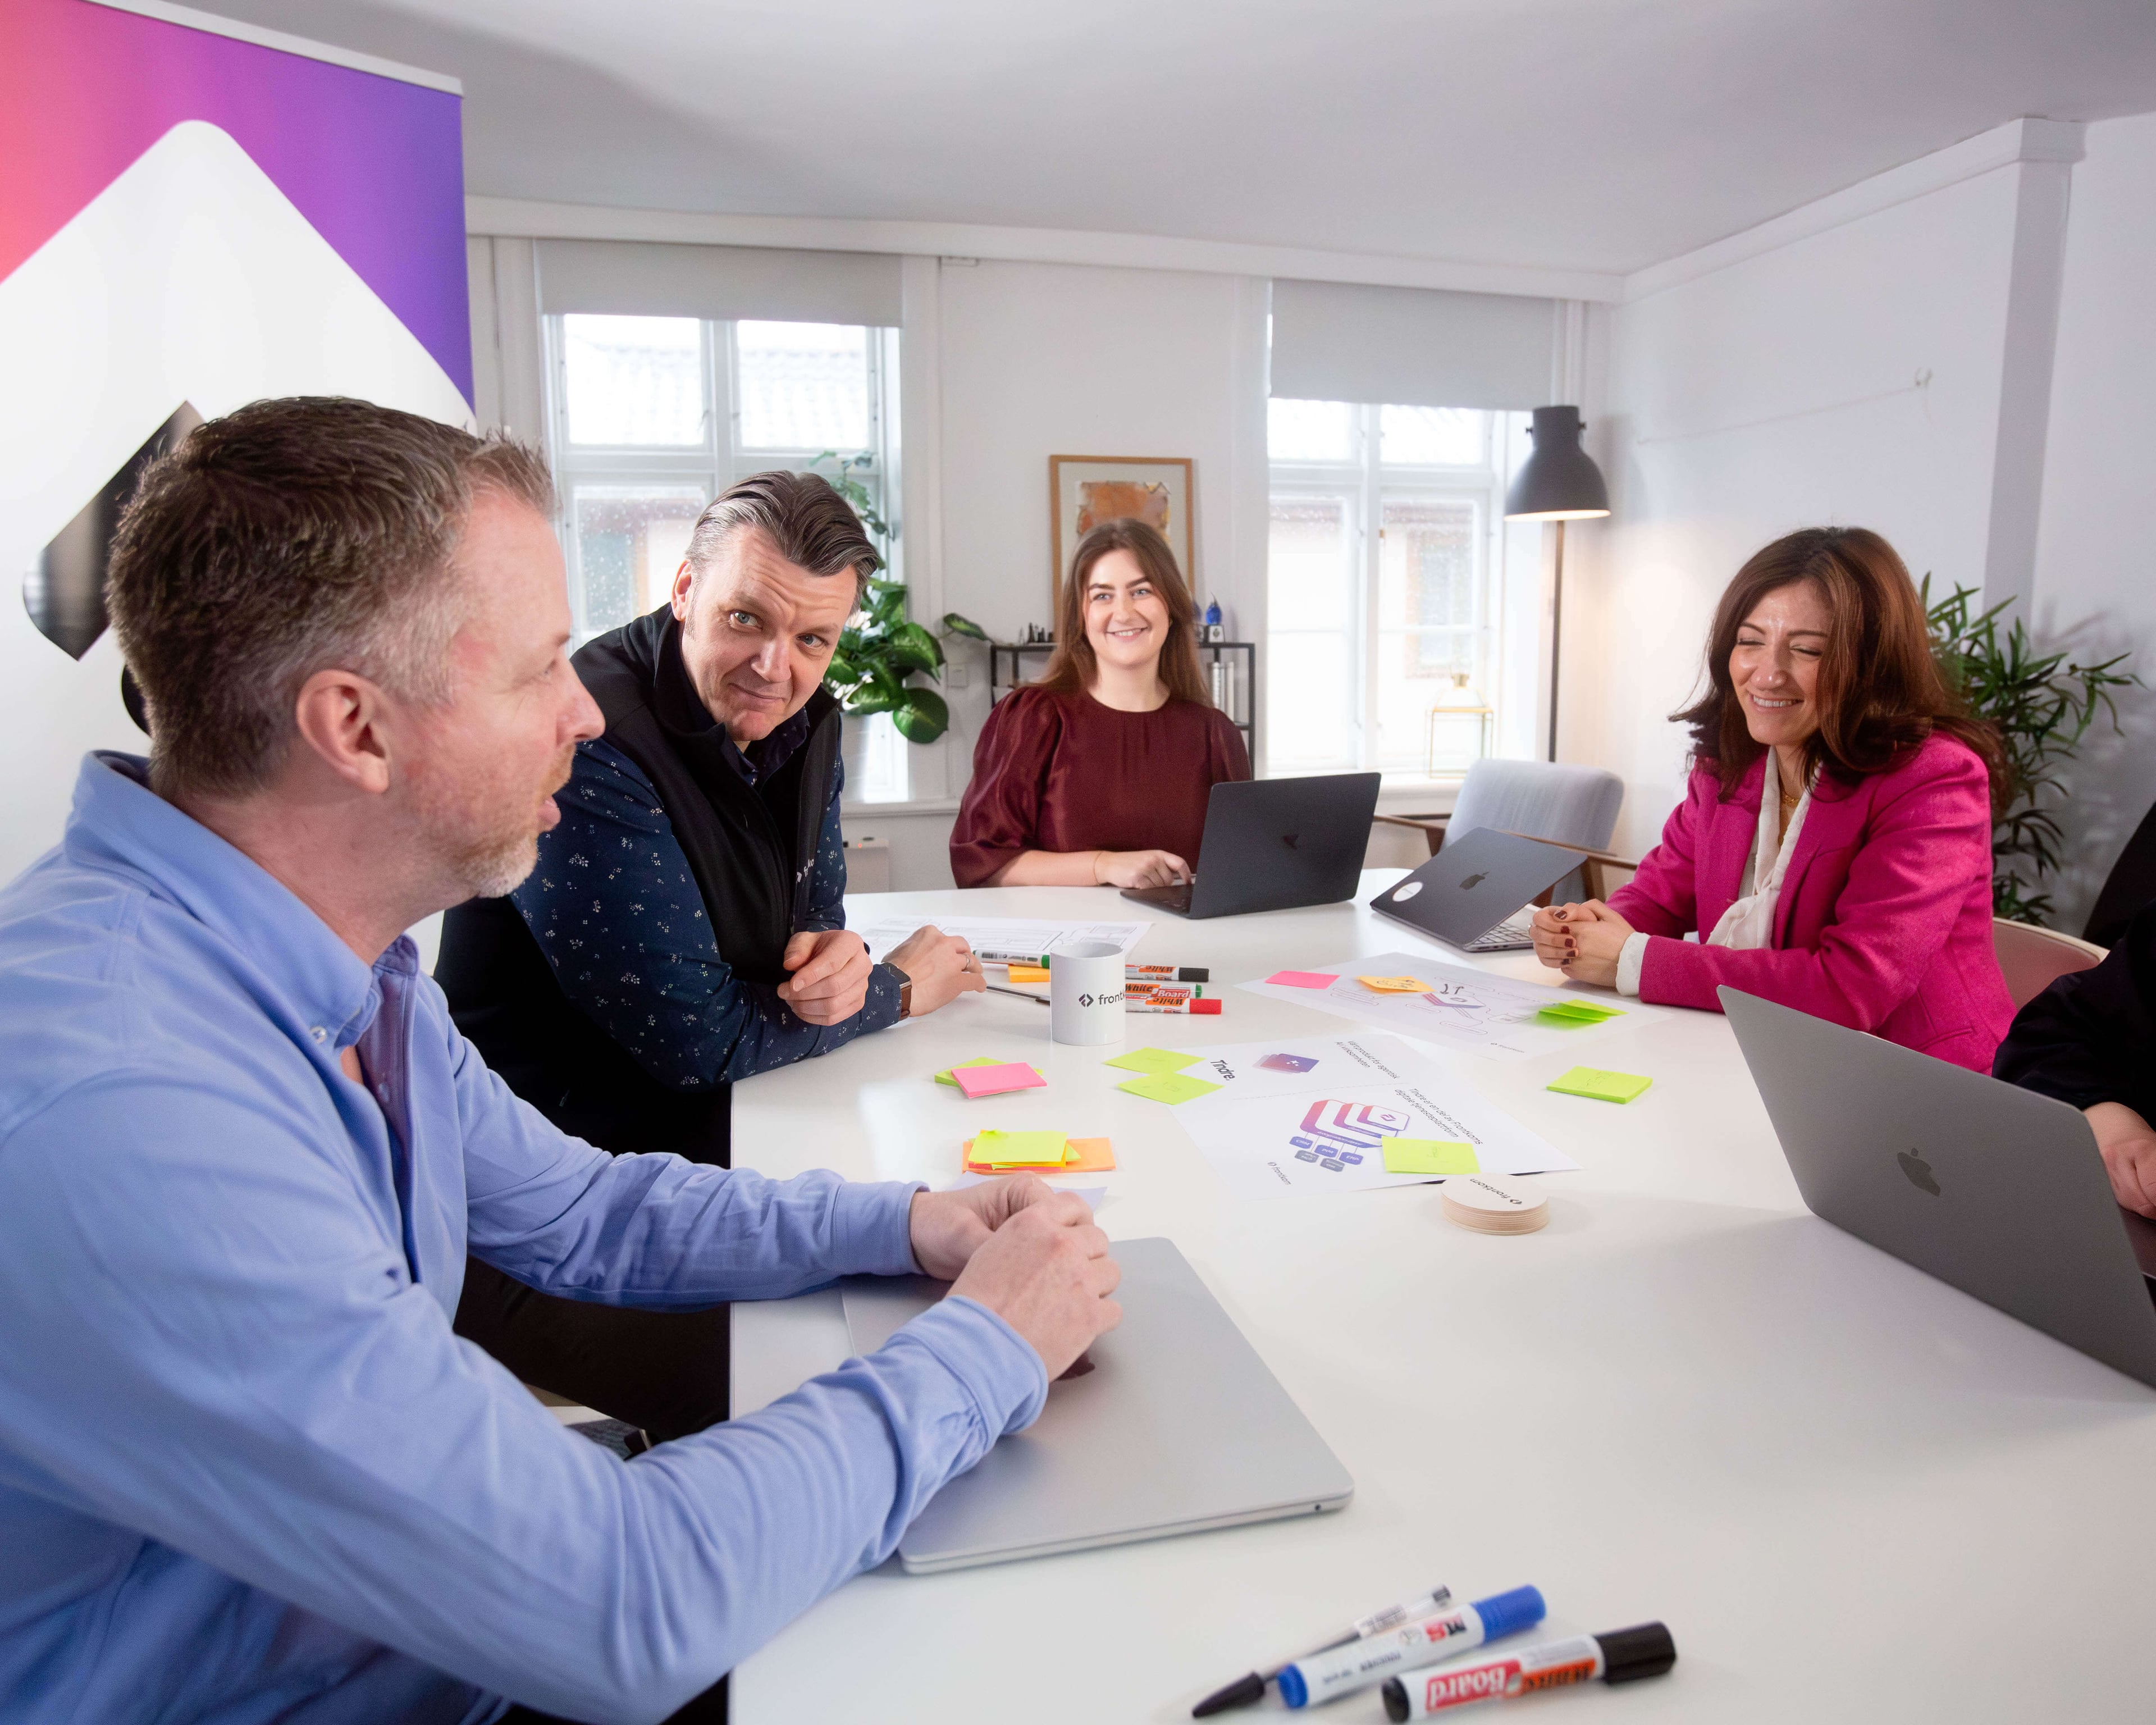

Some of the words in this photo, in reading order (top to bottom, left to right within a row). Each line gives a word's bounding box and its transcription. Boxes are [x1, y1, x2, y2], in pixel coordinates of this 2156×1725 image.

[1158, 989, 1189, 998] Board
[1210, 1060, 1235, 1081] Tindre.
[1395, 1089, 1415, 1102] digitale
[1409, 1088, 1426, 1101] Tindre
[1452, 1121, 1483, 1145] Frontkoms
[1470, 1179, 1510, 1198] frontkom
[1430, 1667, 1506, 1708] Board
